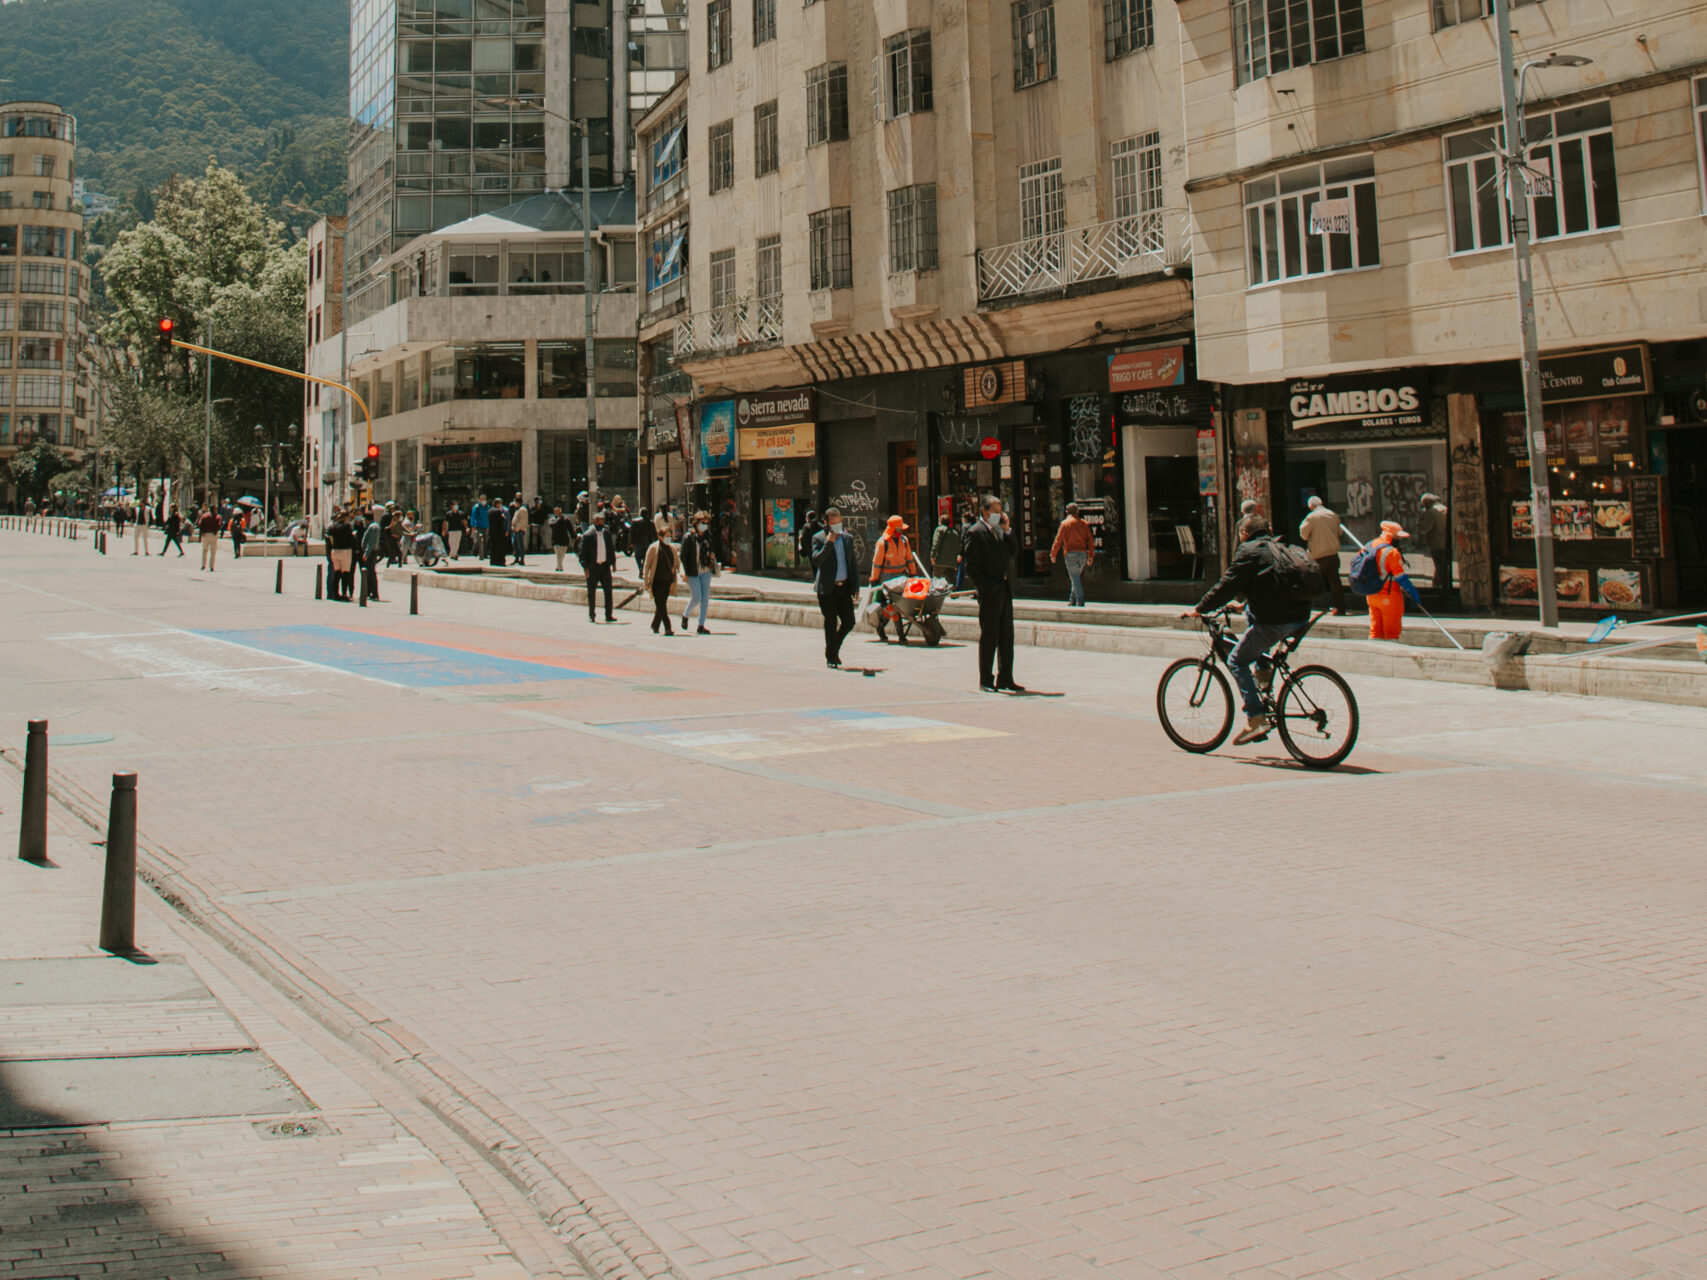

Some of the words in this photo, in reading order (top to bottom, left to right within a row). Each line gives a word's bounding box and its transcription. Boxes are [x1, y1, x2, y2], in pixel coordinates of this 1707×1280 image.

[1112, 372, 1131, 383] TRIGO
[1131, 371, 1136, 381] Y
[1137, 369, 1153, 381] CAFE
[1549, 375, 1583, 388] CENTRO
[1602, 377, 1615, 387] Club
[1615, 374, 1642, 386] Colombia
[750, 398, 776, 415] sierra
[777, 392, 810, 413] nevada
[1289, 386, 1420, 418] CAMBIOS
[1361, 417, 1393, 427] DOLARES
[1398, 415, 1422, 425] EUROS
[1022, 458, 1033, 546] LICORES
[1091, 526, 1097, 535] Y
